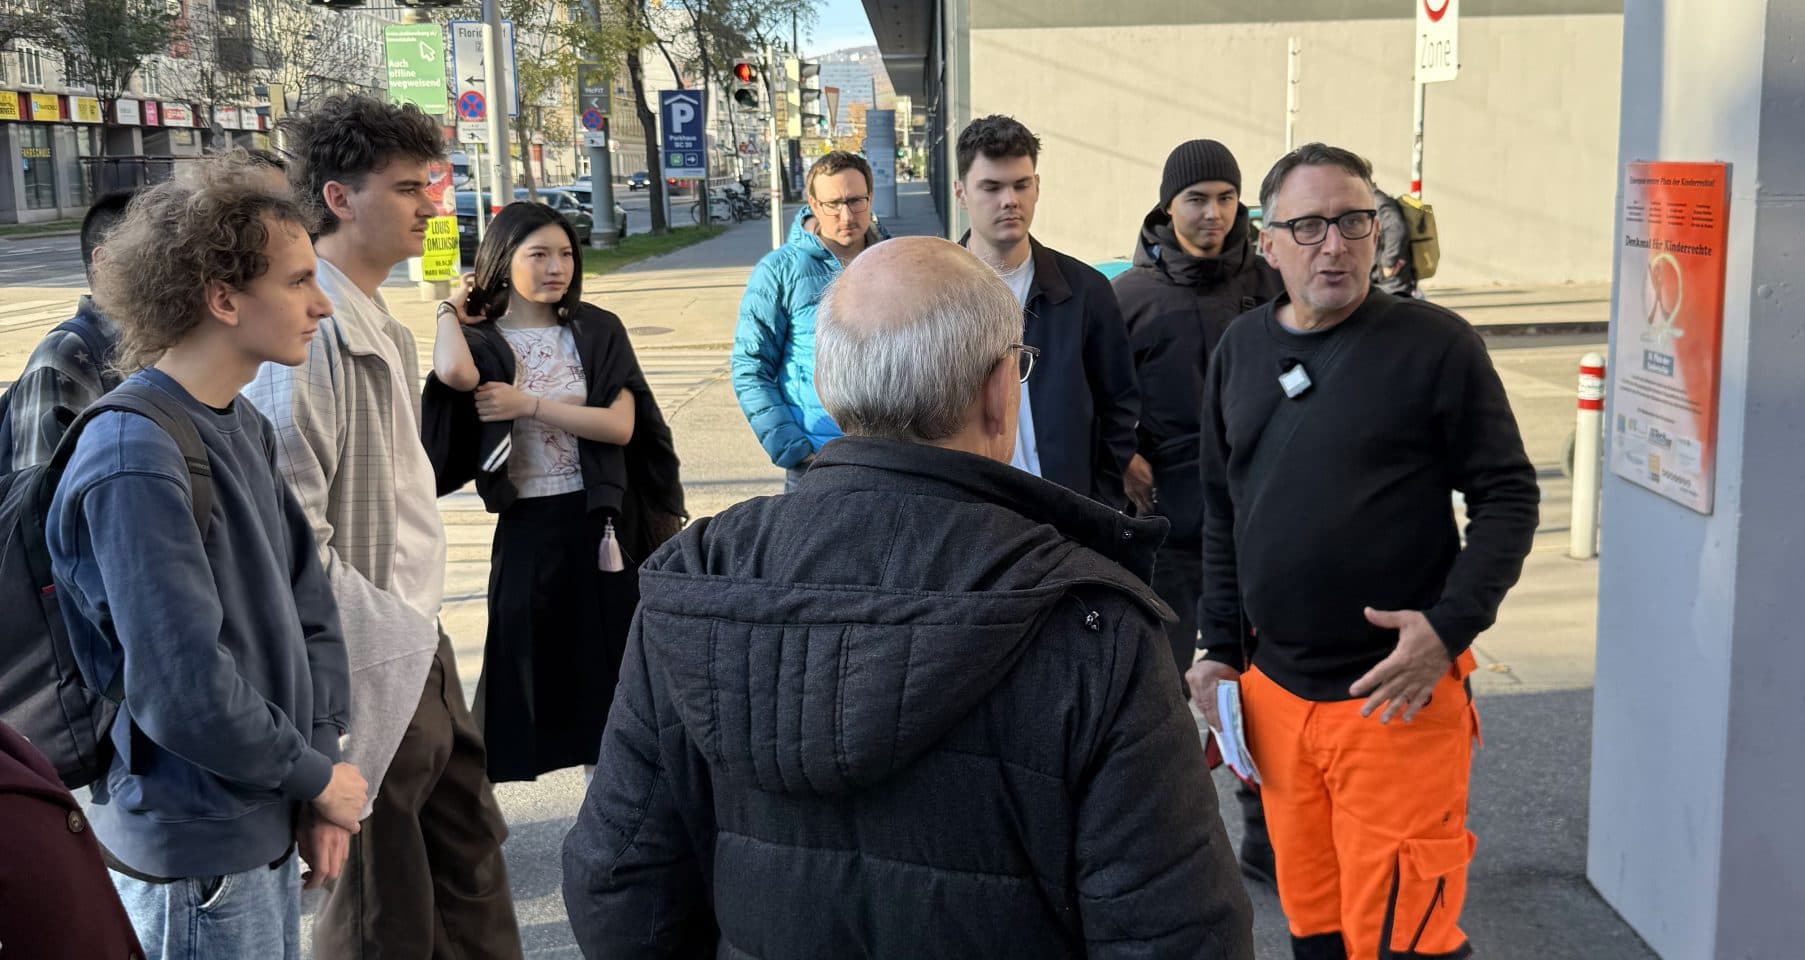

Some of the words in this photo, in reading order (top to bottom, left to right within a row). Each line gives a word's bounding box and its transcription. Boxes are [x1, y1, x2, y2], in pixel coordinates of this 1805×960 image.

[1421, 34, 1451, 69] Zone
[389, 68, 417, 78] offline
[390, 78, 441, 89] wegweisend
[672, 103, 695, 133] P
[431, 220, 451, 235] LOUIS
[1625, 235, 1652, 249] Denkmal
[1664, 240, 1713, 256] Kinderrechte
